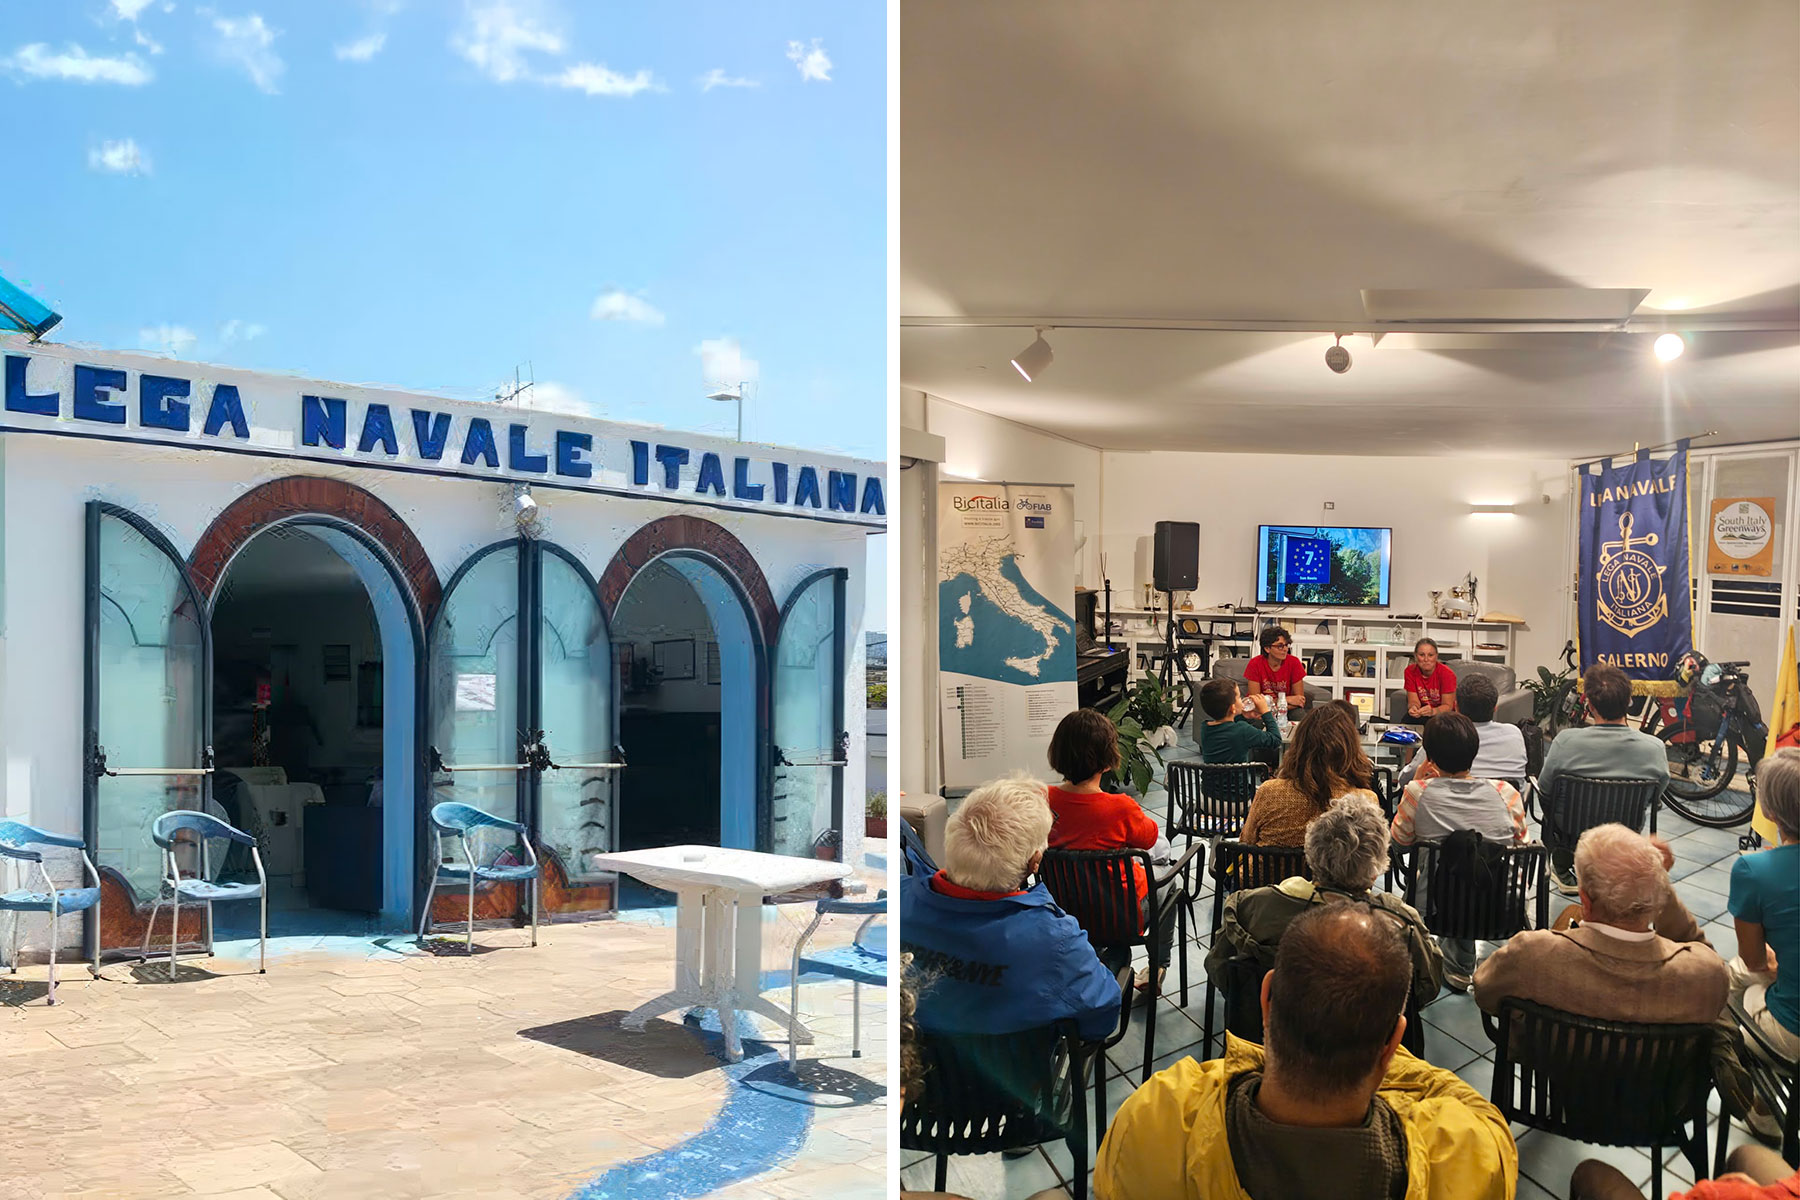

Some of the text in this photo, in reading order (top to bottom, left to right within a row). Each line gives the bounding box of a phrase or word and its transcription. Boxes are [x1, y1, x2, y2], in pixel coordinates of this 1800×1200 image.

[5, 355, 886, 515] LEGA NAVALE ITALIANA
[1616, 474, 1676, 501] NAVALE
[953, 495, 1009, 510] Bicitalia
[1033, 503, 1052, 511] FIAB
[1717, 524, 1767, 534] Greenways
[1719, 515, 1767, 527] South Italy
[1304, 550, 1315, 566] 7
[1601, 553, 1657, 583] LEGA NAVALE
[1610, 601, 1653, 617] ITALIANA
[1597, 652, 1669, 668] SALERNO
